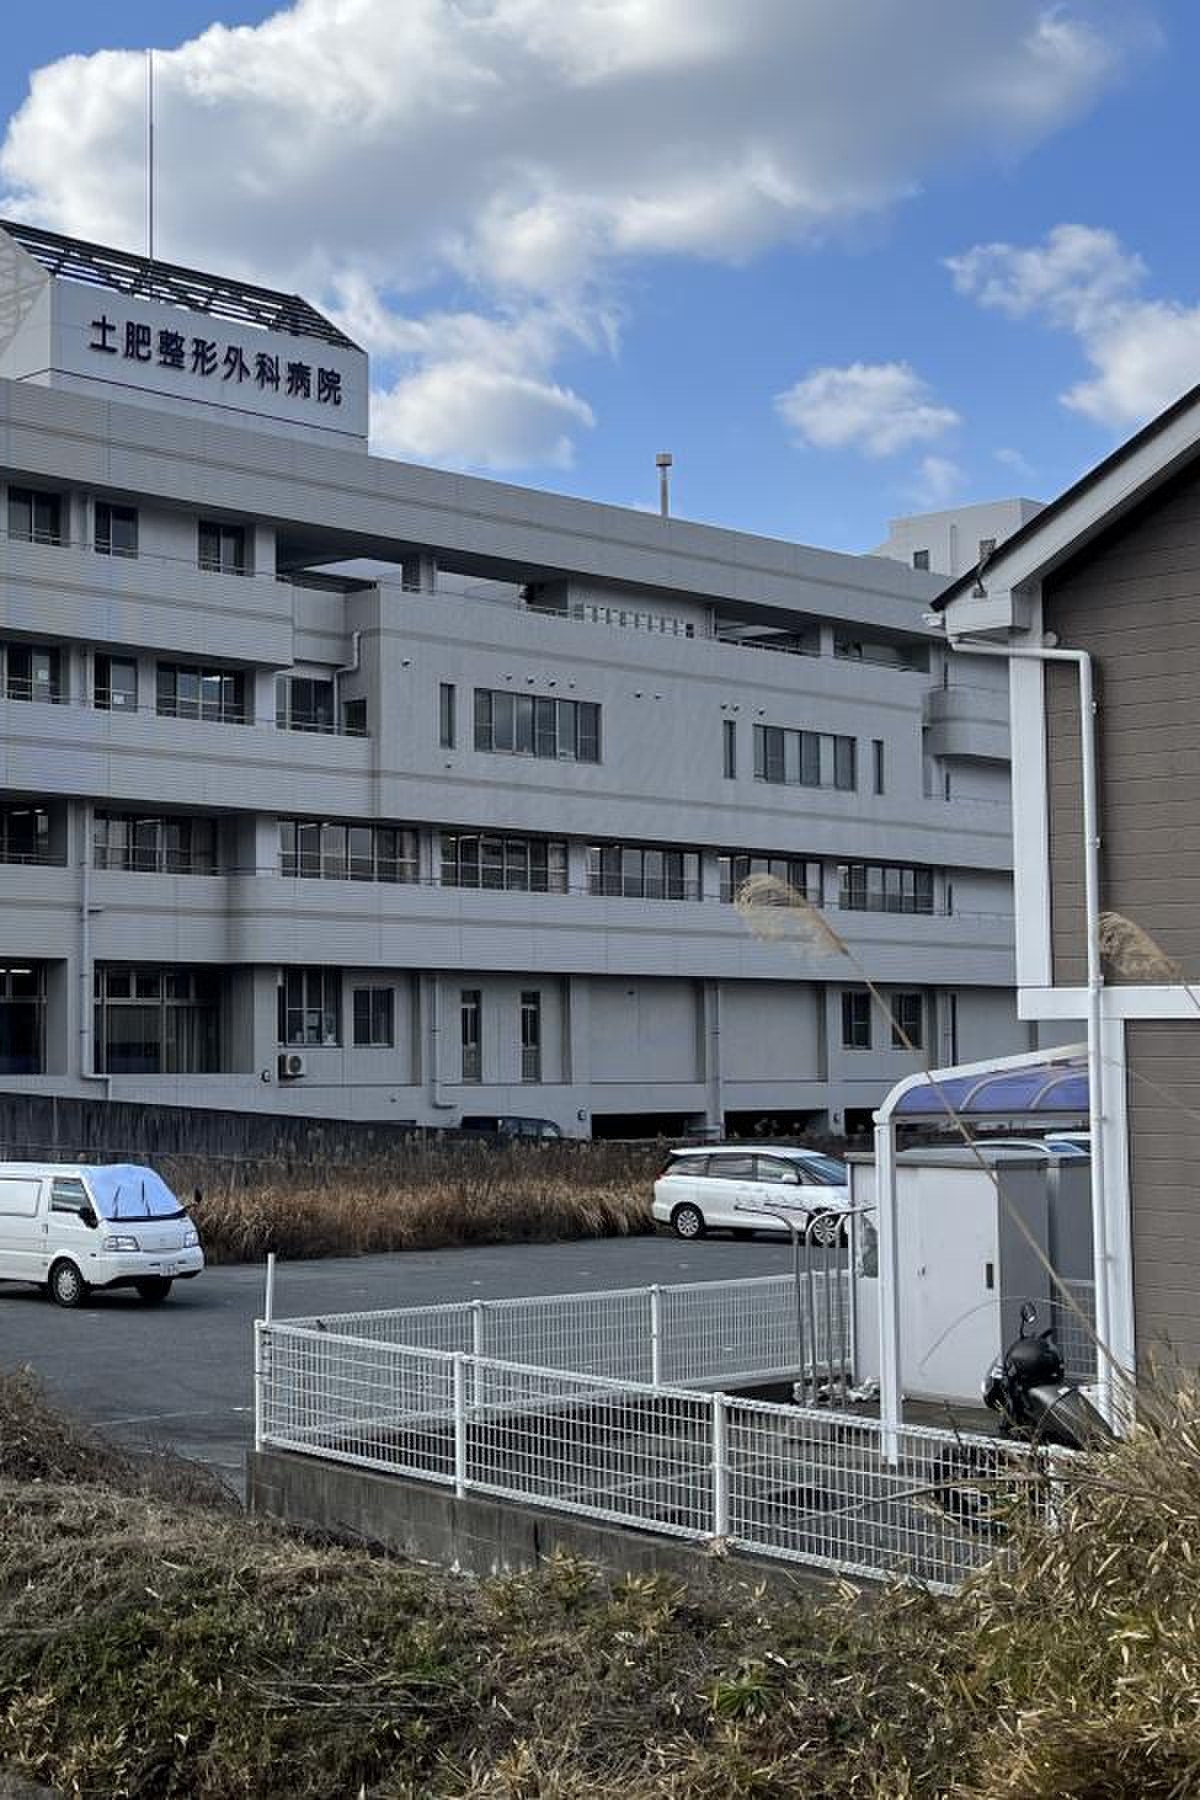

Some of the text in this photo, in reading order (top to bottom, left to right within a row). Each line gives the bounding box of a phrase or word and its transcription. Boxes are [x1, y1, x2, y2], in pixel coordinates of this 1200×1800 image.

[89, 315, 342, 405] 土肥整形外科病院
